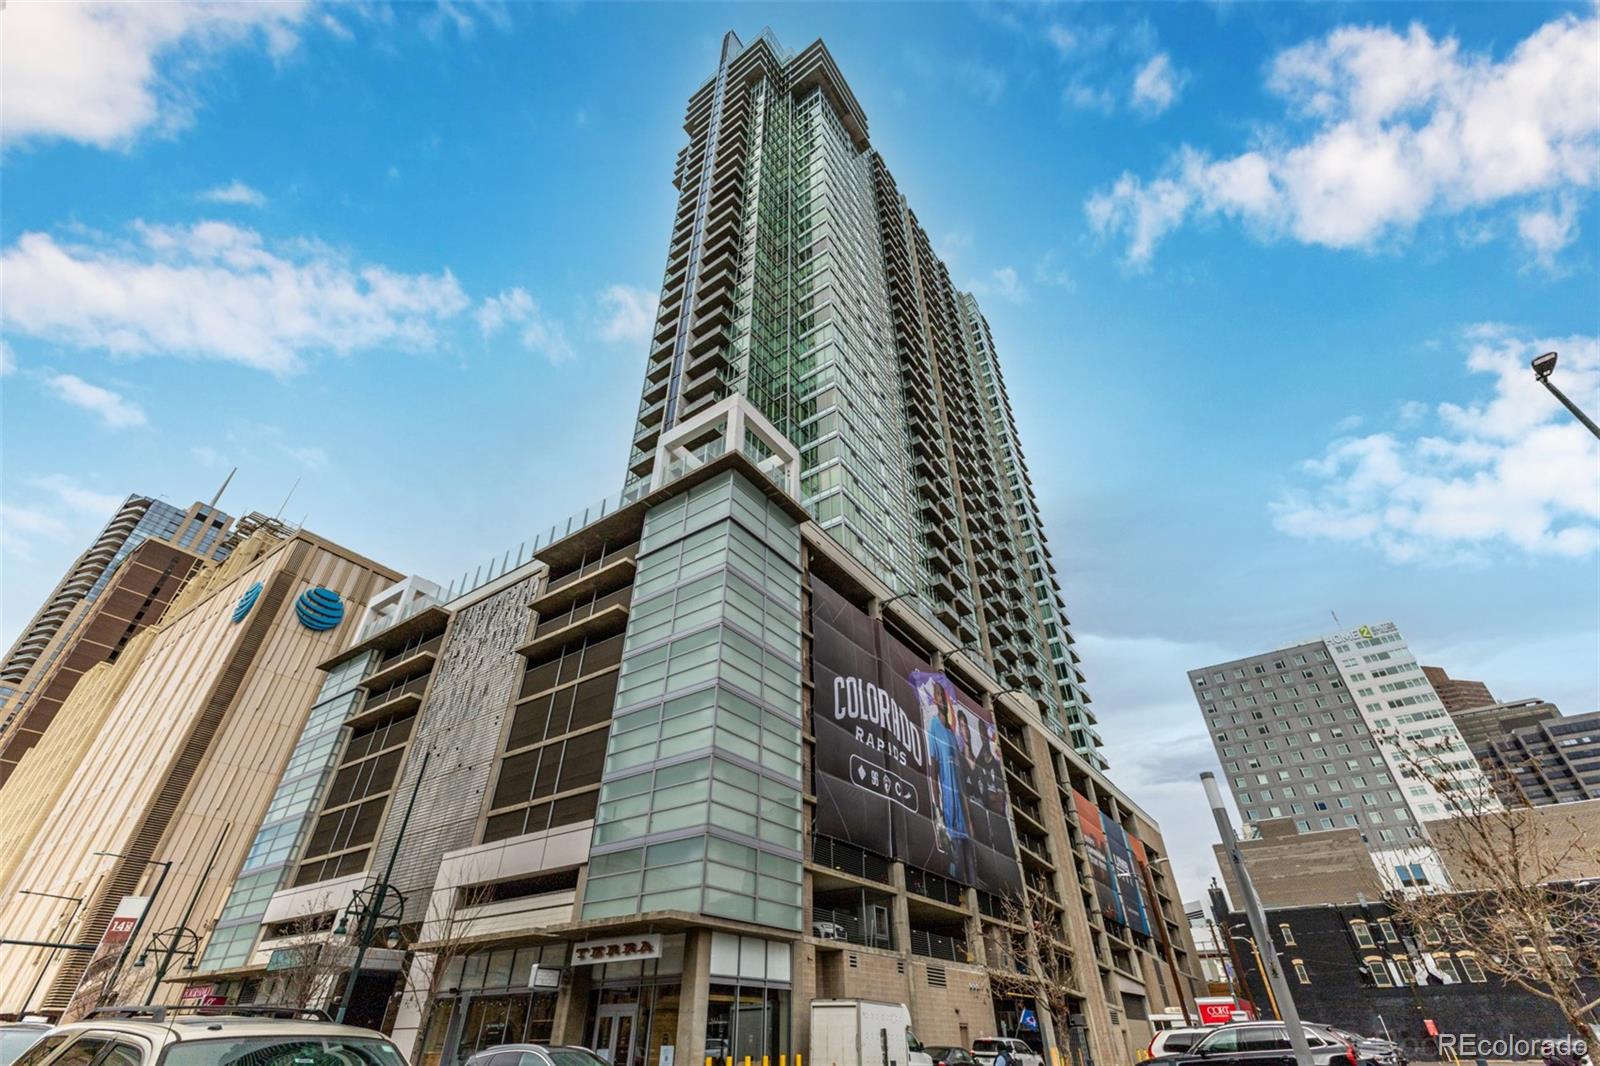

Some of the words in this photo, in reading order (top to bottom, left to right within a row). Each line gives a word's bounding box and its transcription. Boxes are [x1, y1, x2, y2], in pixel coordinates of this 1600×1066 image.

[833, 676, 922, 767] COLORADO
[855, 725, 907, 766] RAPIDS
[576, 941, 654, 960] TERRA
[1206, 1005, 1230, 1016] CORT
